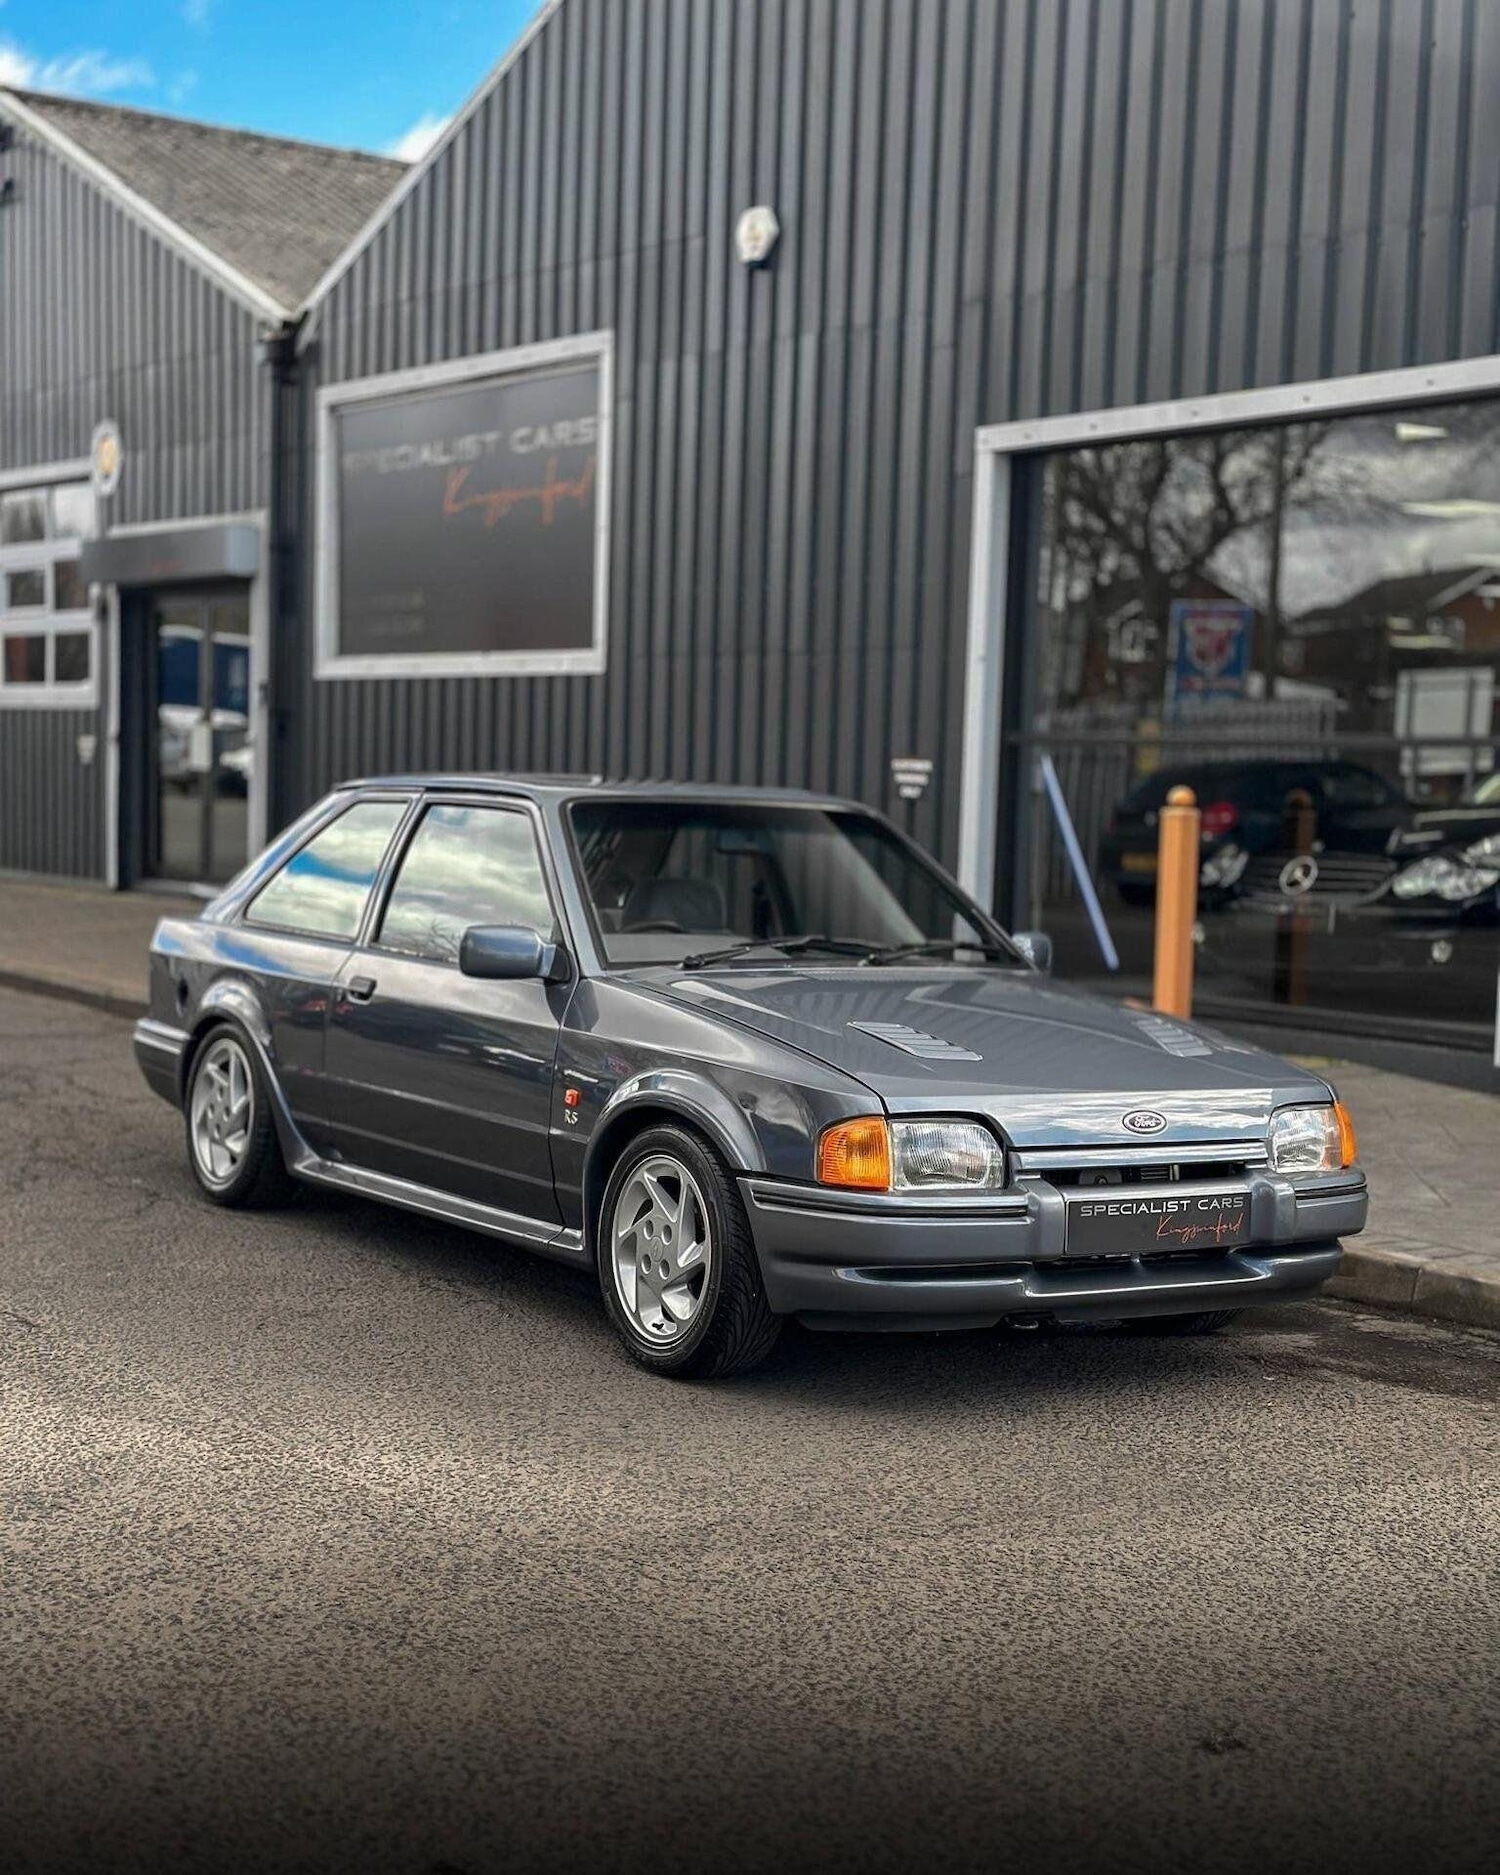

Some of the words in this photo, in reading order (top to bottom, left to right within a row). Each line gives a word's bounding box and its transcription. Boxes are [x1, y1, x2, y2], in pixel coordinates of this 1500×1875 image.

[509, 416, 598, 454] CARS
[564, 1108, 579, 1125] RS
[1080, 1200, 1191, 1217] SPECIALIST
[1197, 1196, 1244, 1211] CARS
